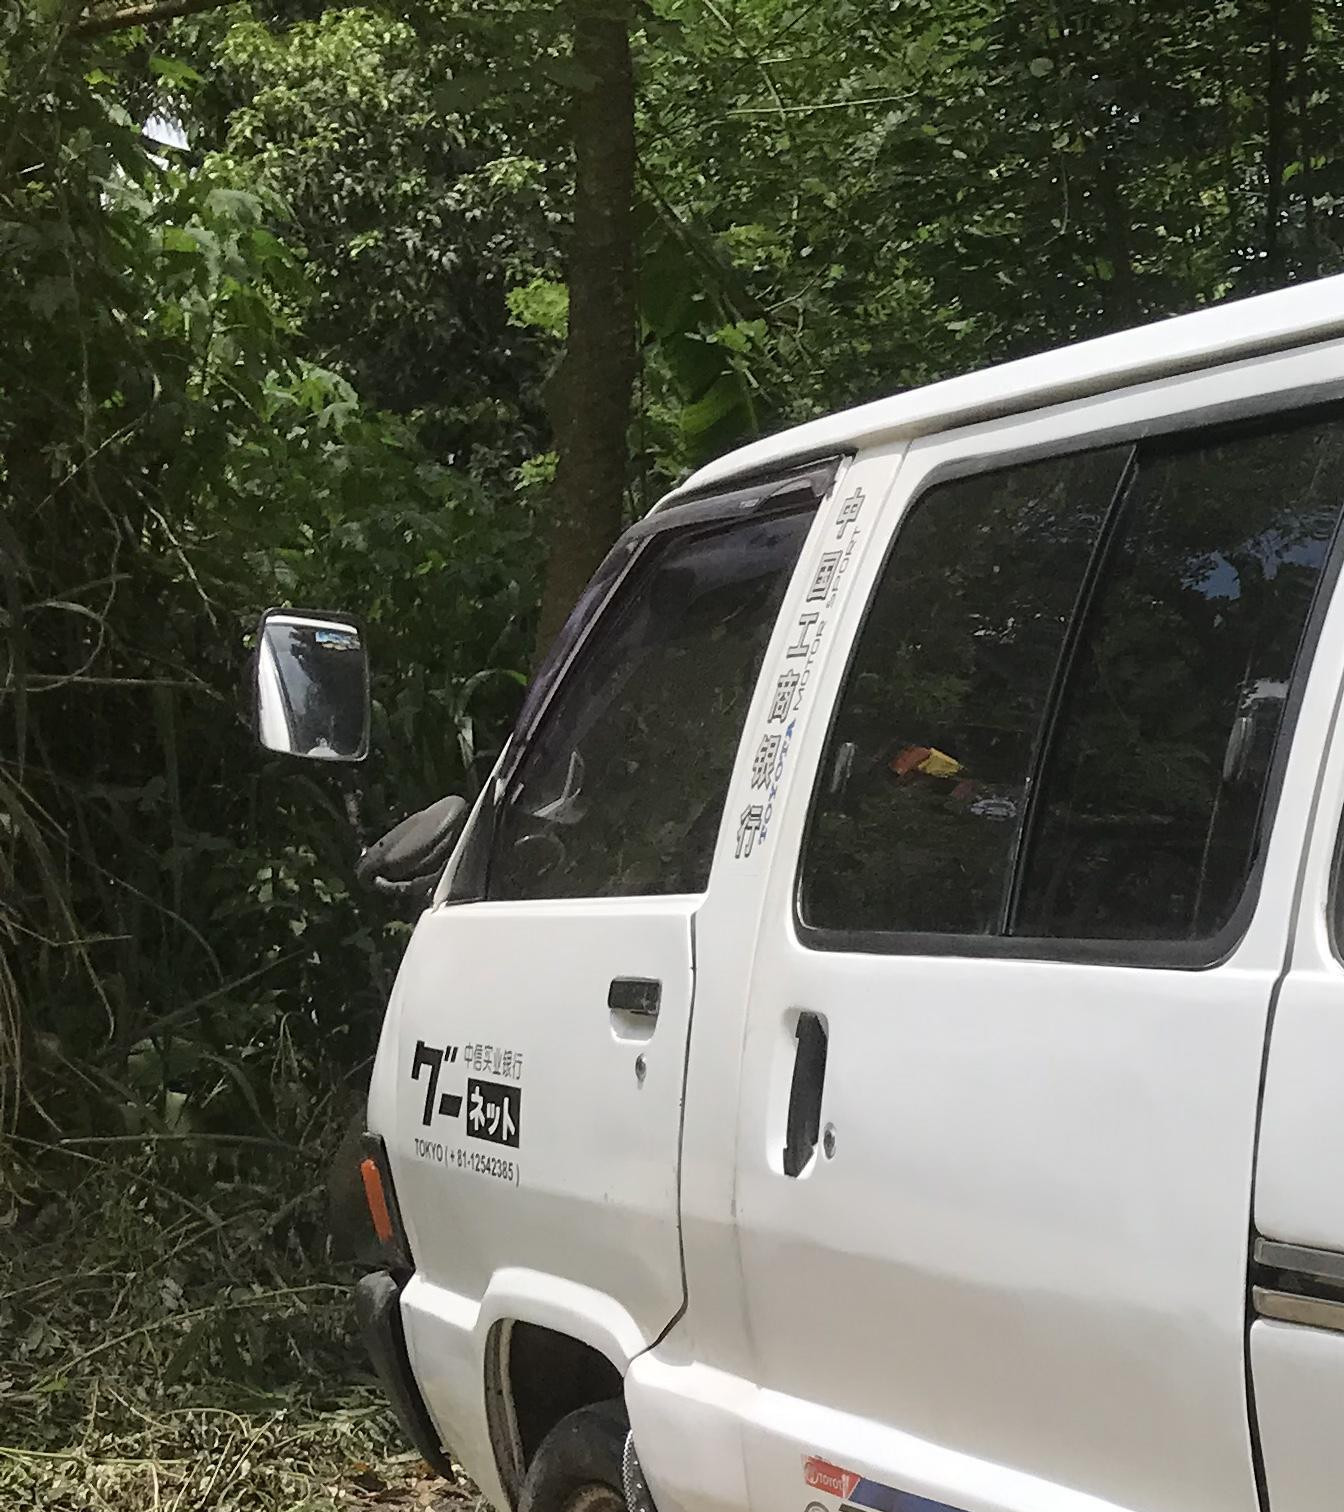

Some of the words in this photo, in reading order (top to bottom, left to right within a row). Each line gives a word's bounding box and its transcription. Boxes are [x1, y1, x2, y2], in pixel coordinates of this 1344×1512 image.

[758, 718, 797, 845] TOYOTA
[792, 620, 827, 711] MOTOR
[825, 525, 862, 608] SPORT
[468, 1085, 517, 1141] ネット
[415, 1138, 444, 1164] TOKYO
